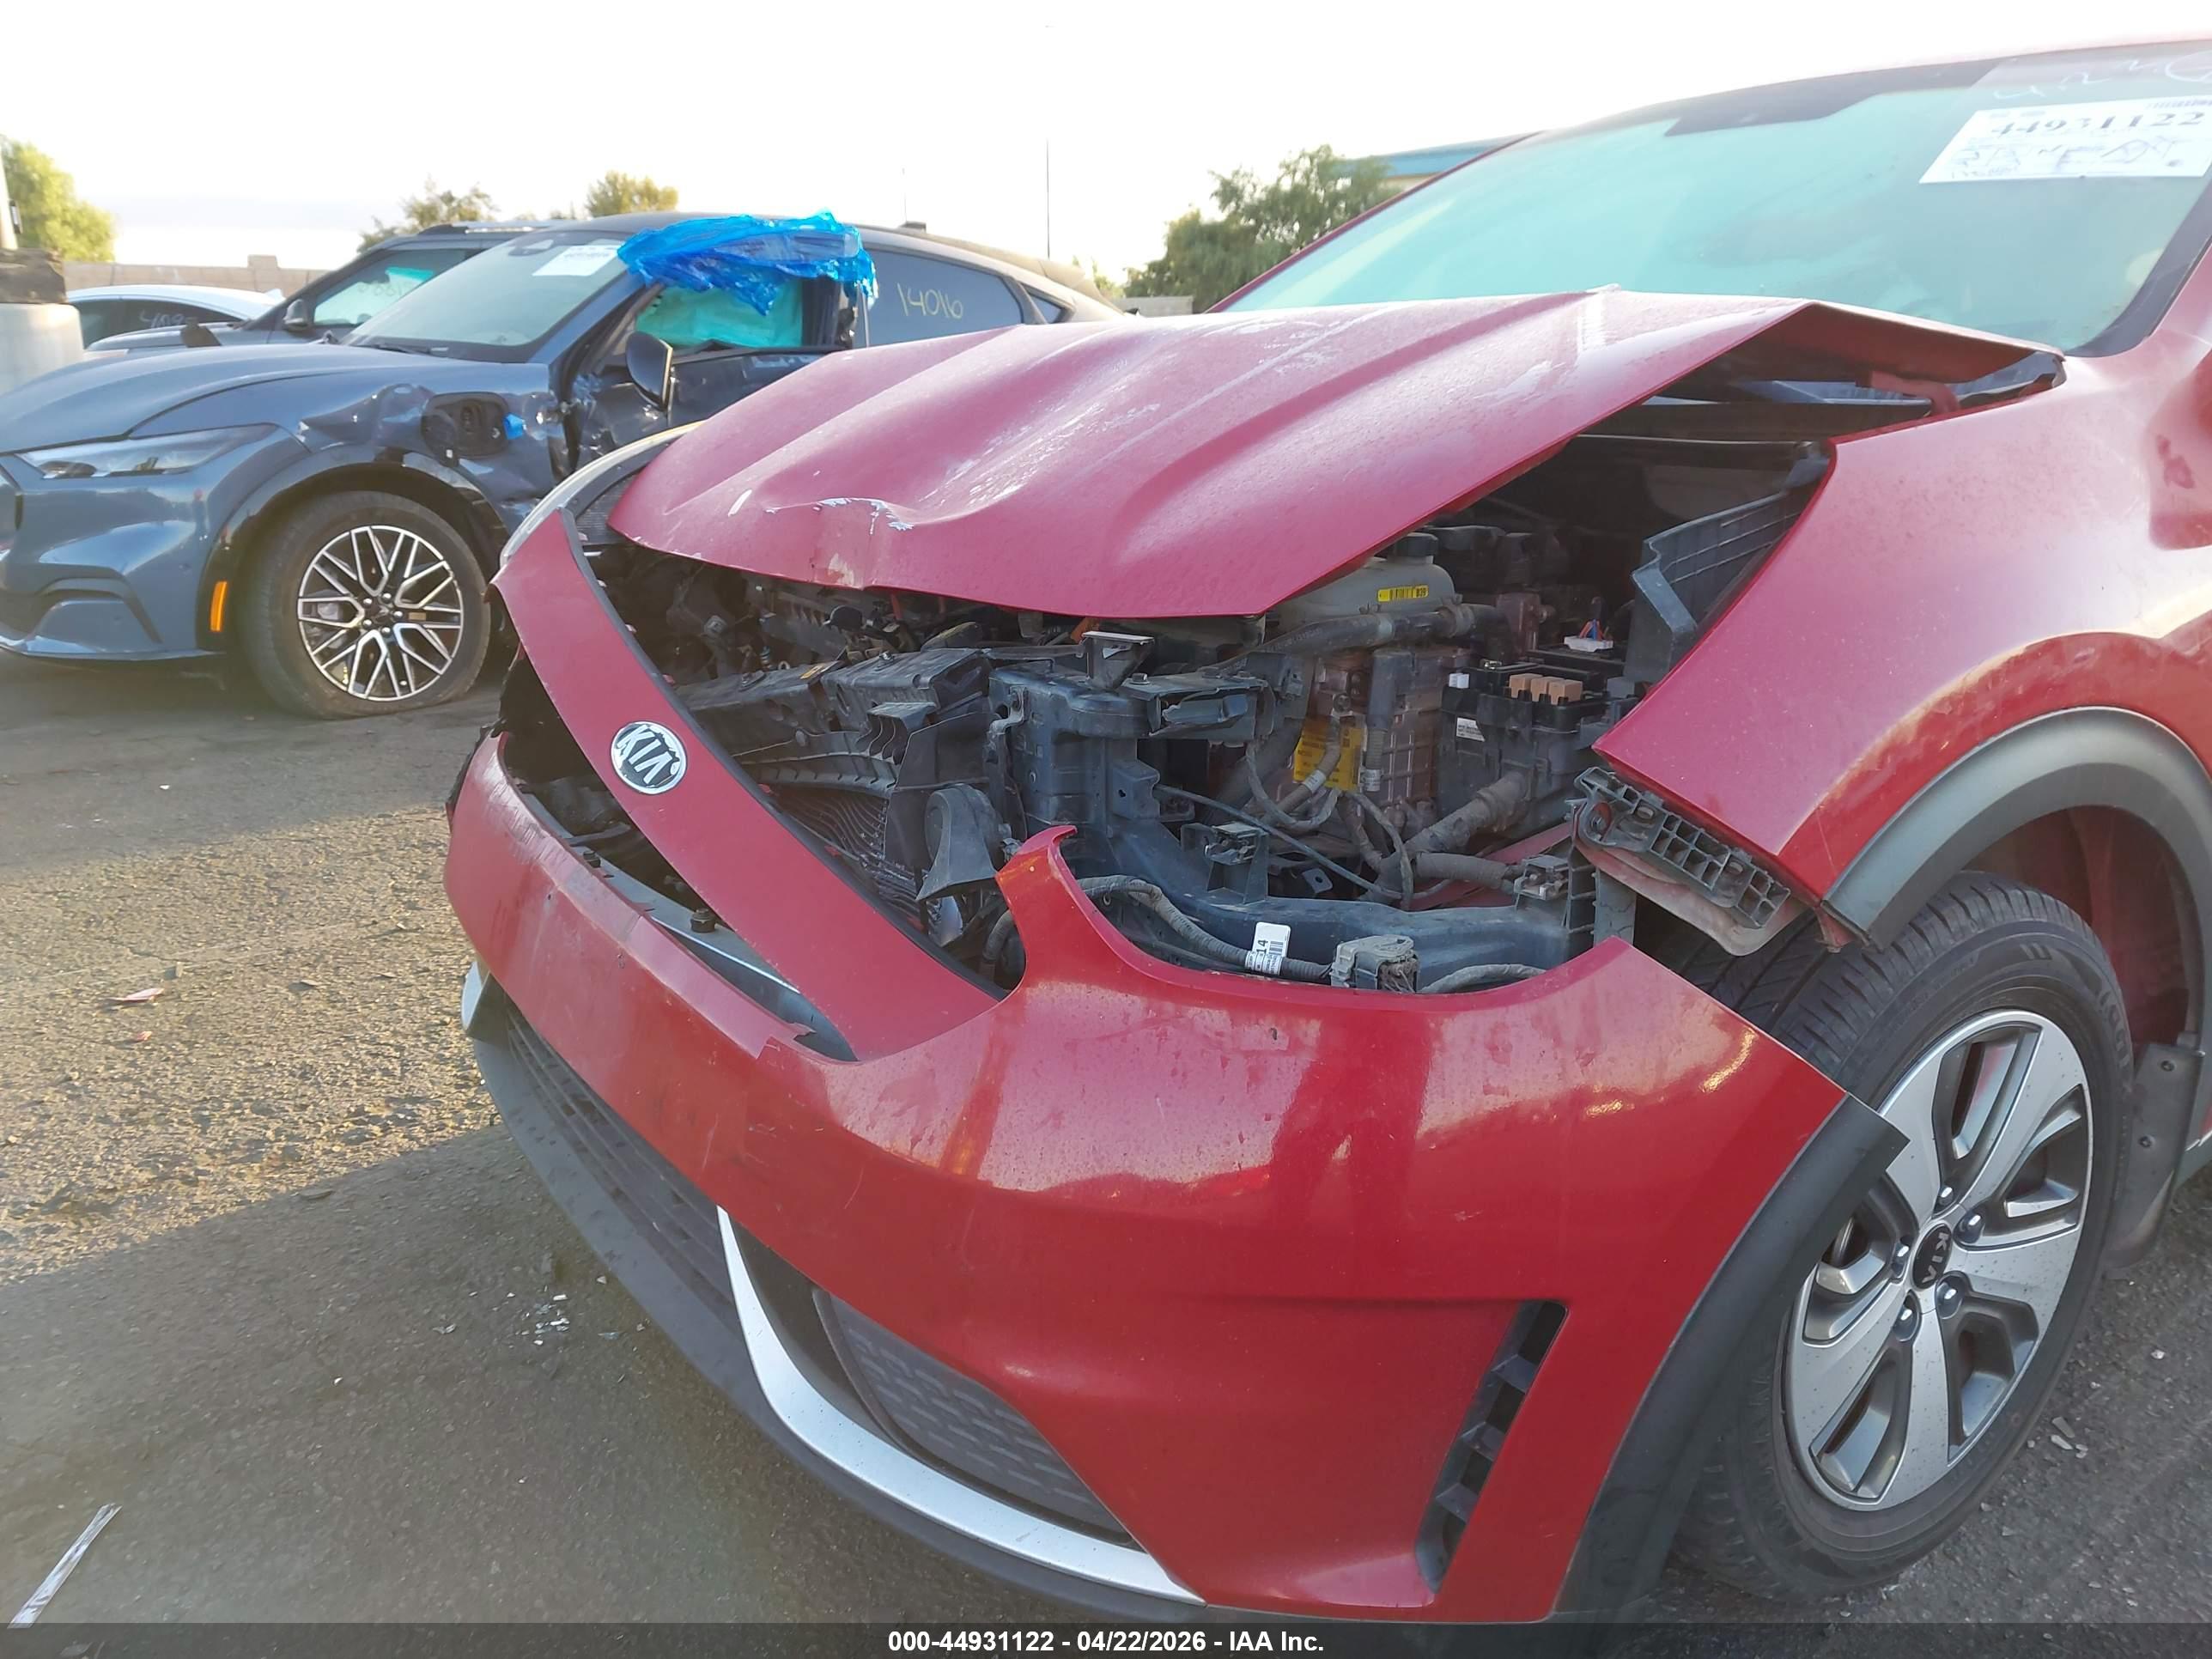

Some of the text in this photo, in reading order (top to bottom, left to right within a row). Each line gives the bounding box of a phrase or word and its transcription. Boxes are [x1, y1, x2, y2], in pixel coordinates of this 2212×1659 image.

[896, 283, 963, 319] 14016
[616, 724, 673, 785] KIA
[1922, 1232, 1950, 1284] KIA
